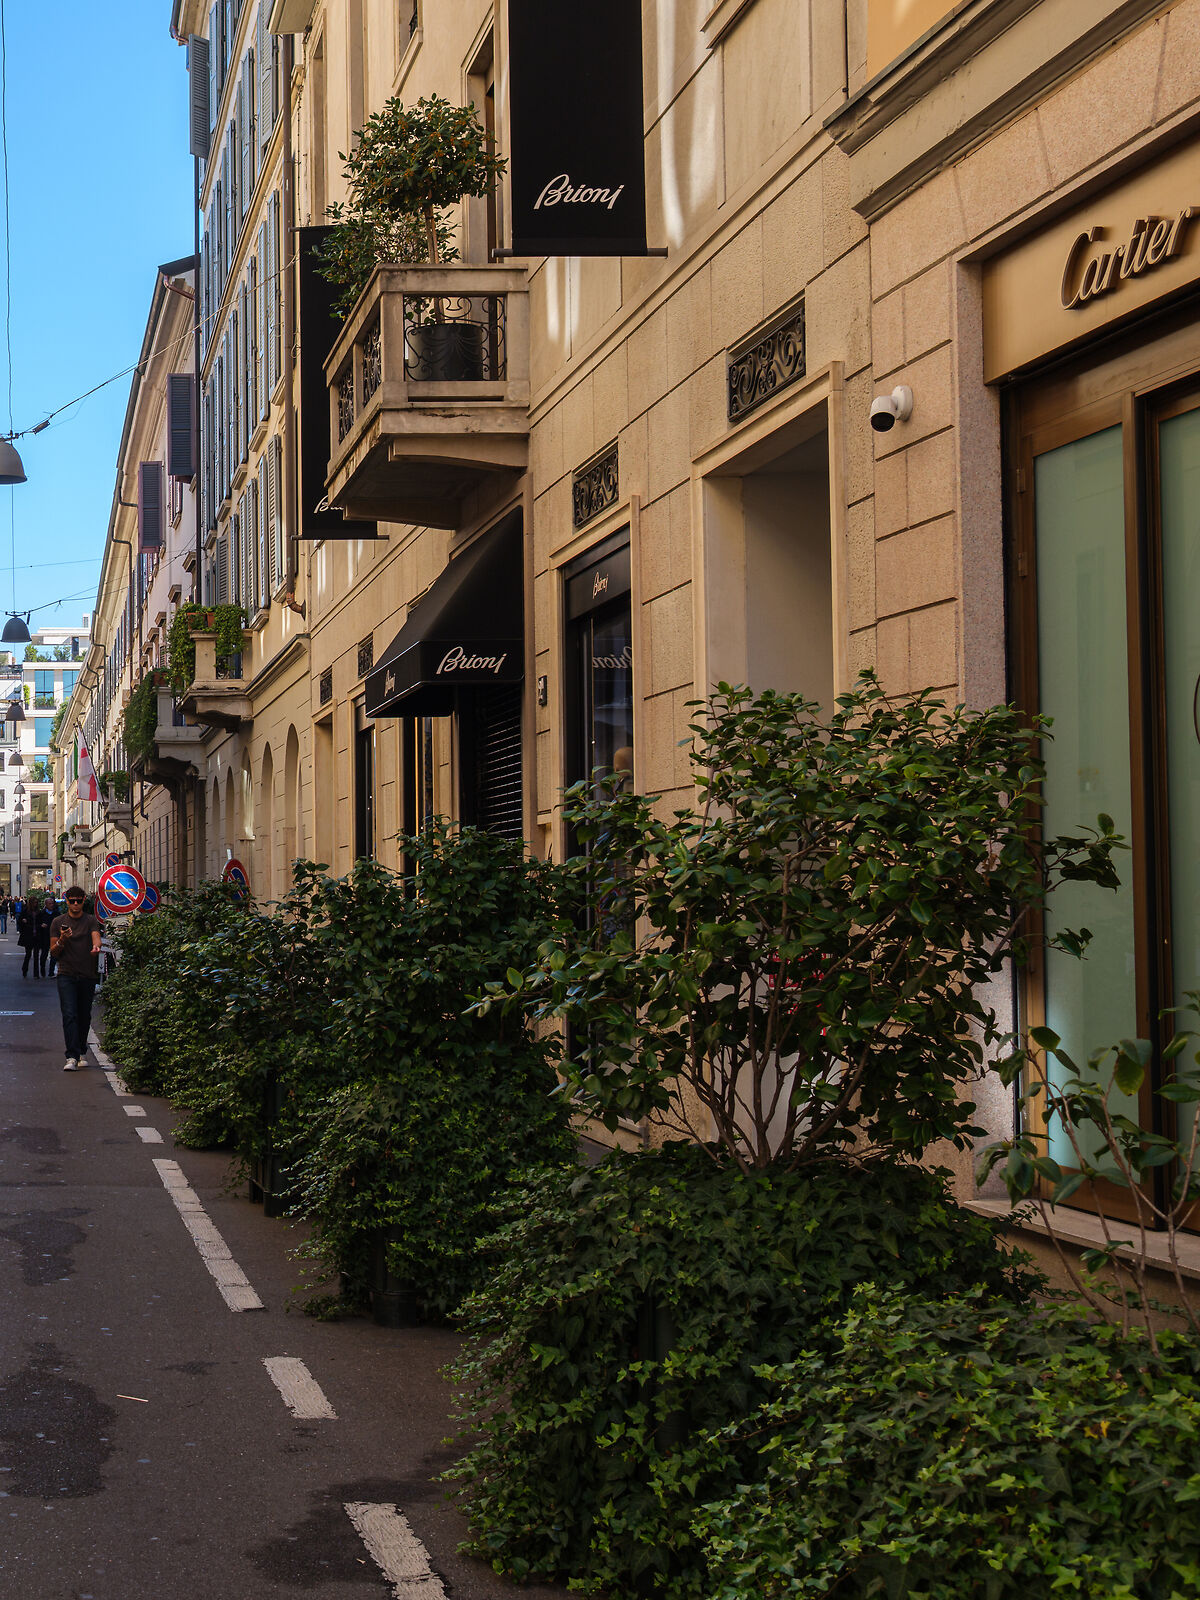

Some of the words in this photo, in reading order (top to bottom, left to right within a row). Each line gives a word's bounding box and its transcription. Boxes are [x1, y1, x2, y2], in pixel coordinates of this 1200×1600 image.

[533, 173, 625, 210] Brioni
[1060, 207, 1193, 310] Cartier
[436, 646, 508, 675] Brioni
